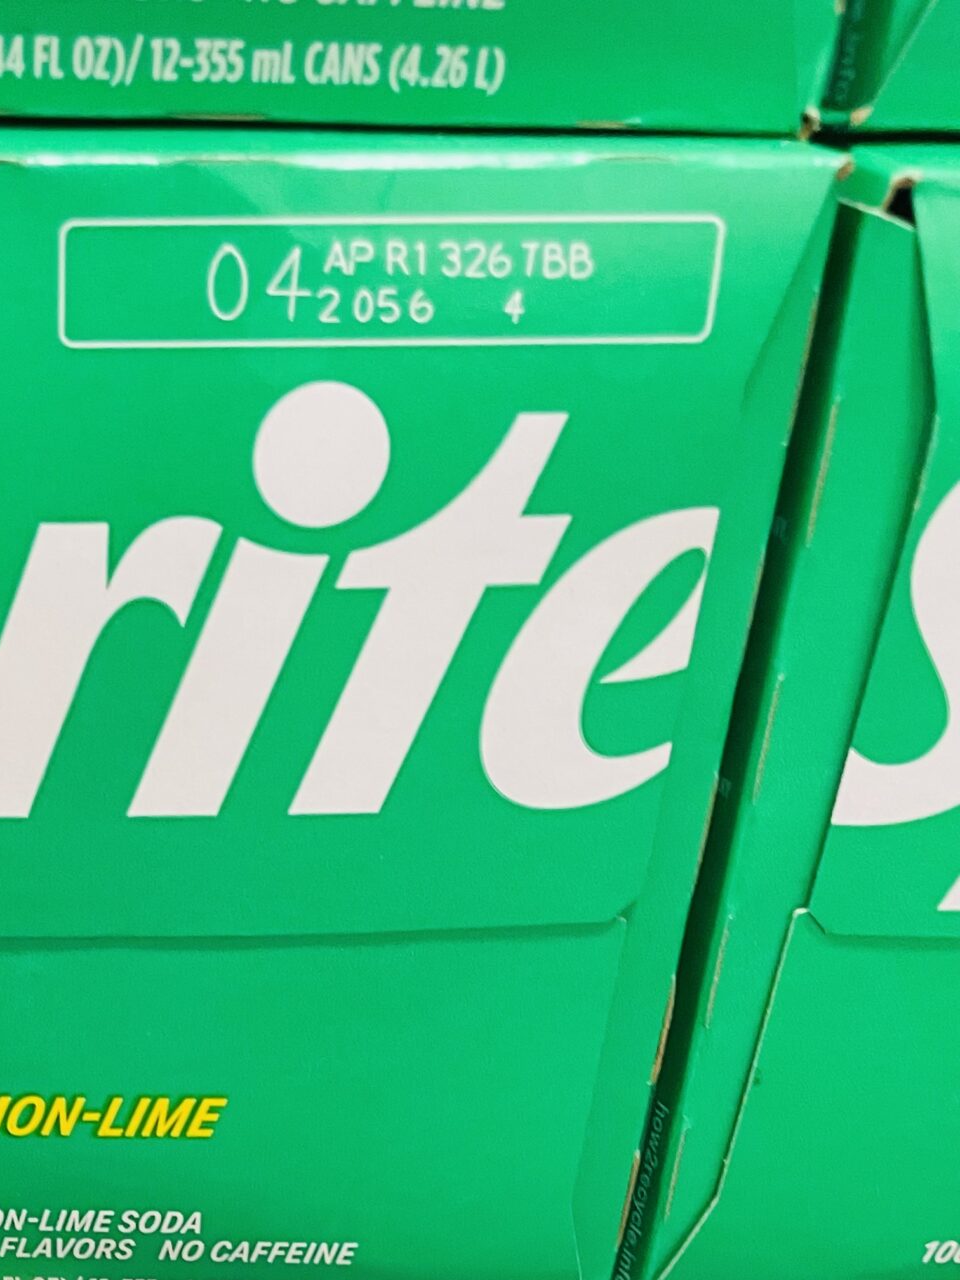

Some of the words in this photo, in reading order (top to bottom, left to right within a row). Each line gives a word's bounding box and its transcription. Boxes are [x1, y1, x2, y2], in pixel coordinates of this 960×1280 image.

[33, 34, 65, 79] FL
[150, 37, 245, 83] 12-355
[304, 41, 382, 86] CANS
[388, 44, 470, 93] (4.26
[474, 46, 506, 96] L)
[503, 289, 526, 325] 4
[116, 1210, 203, 1235] SODA
[157, 1239, 205, 1263] NO
[209, 1240, 359, 1266] CAFFEINE
